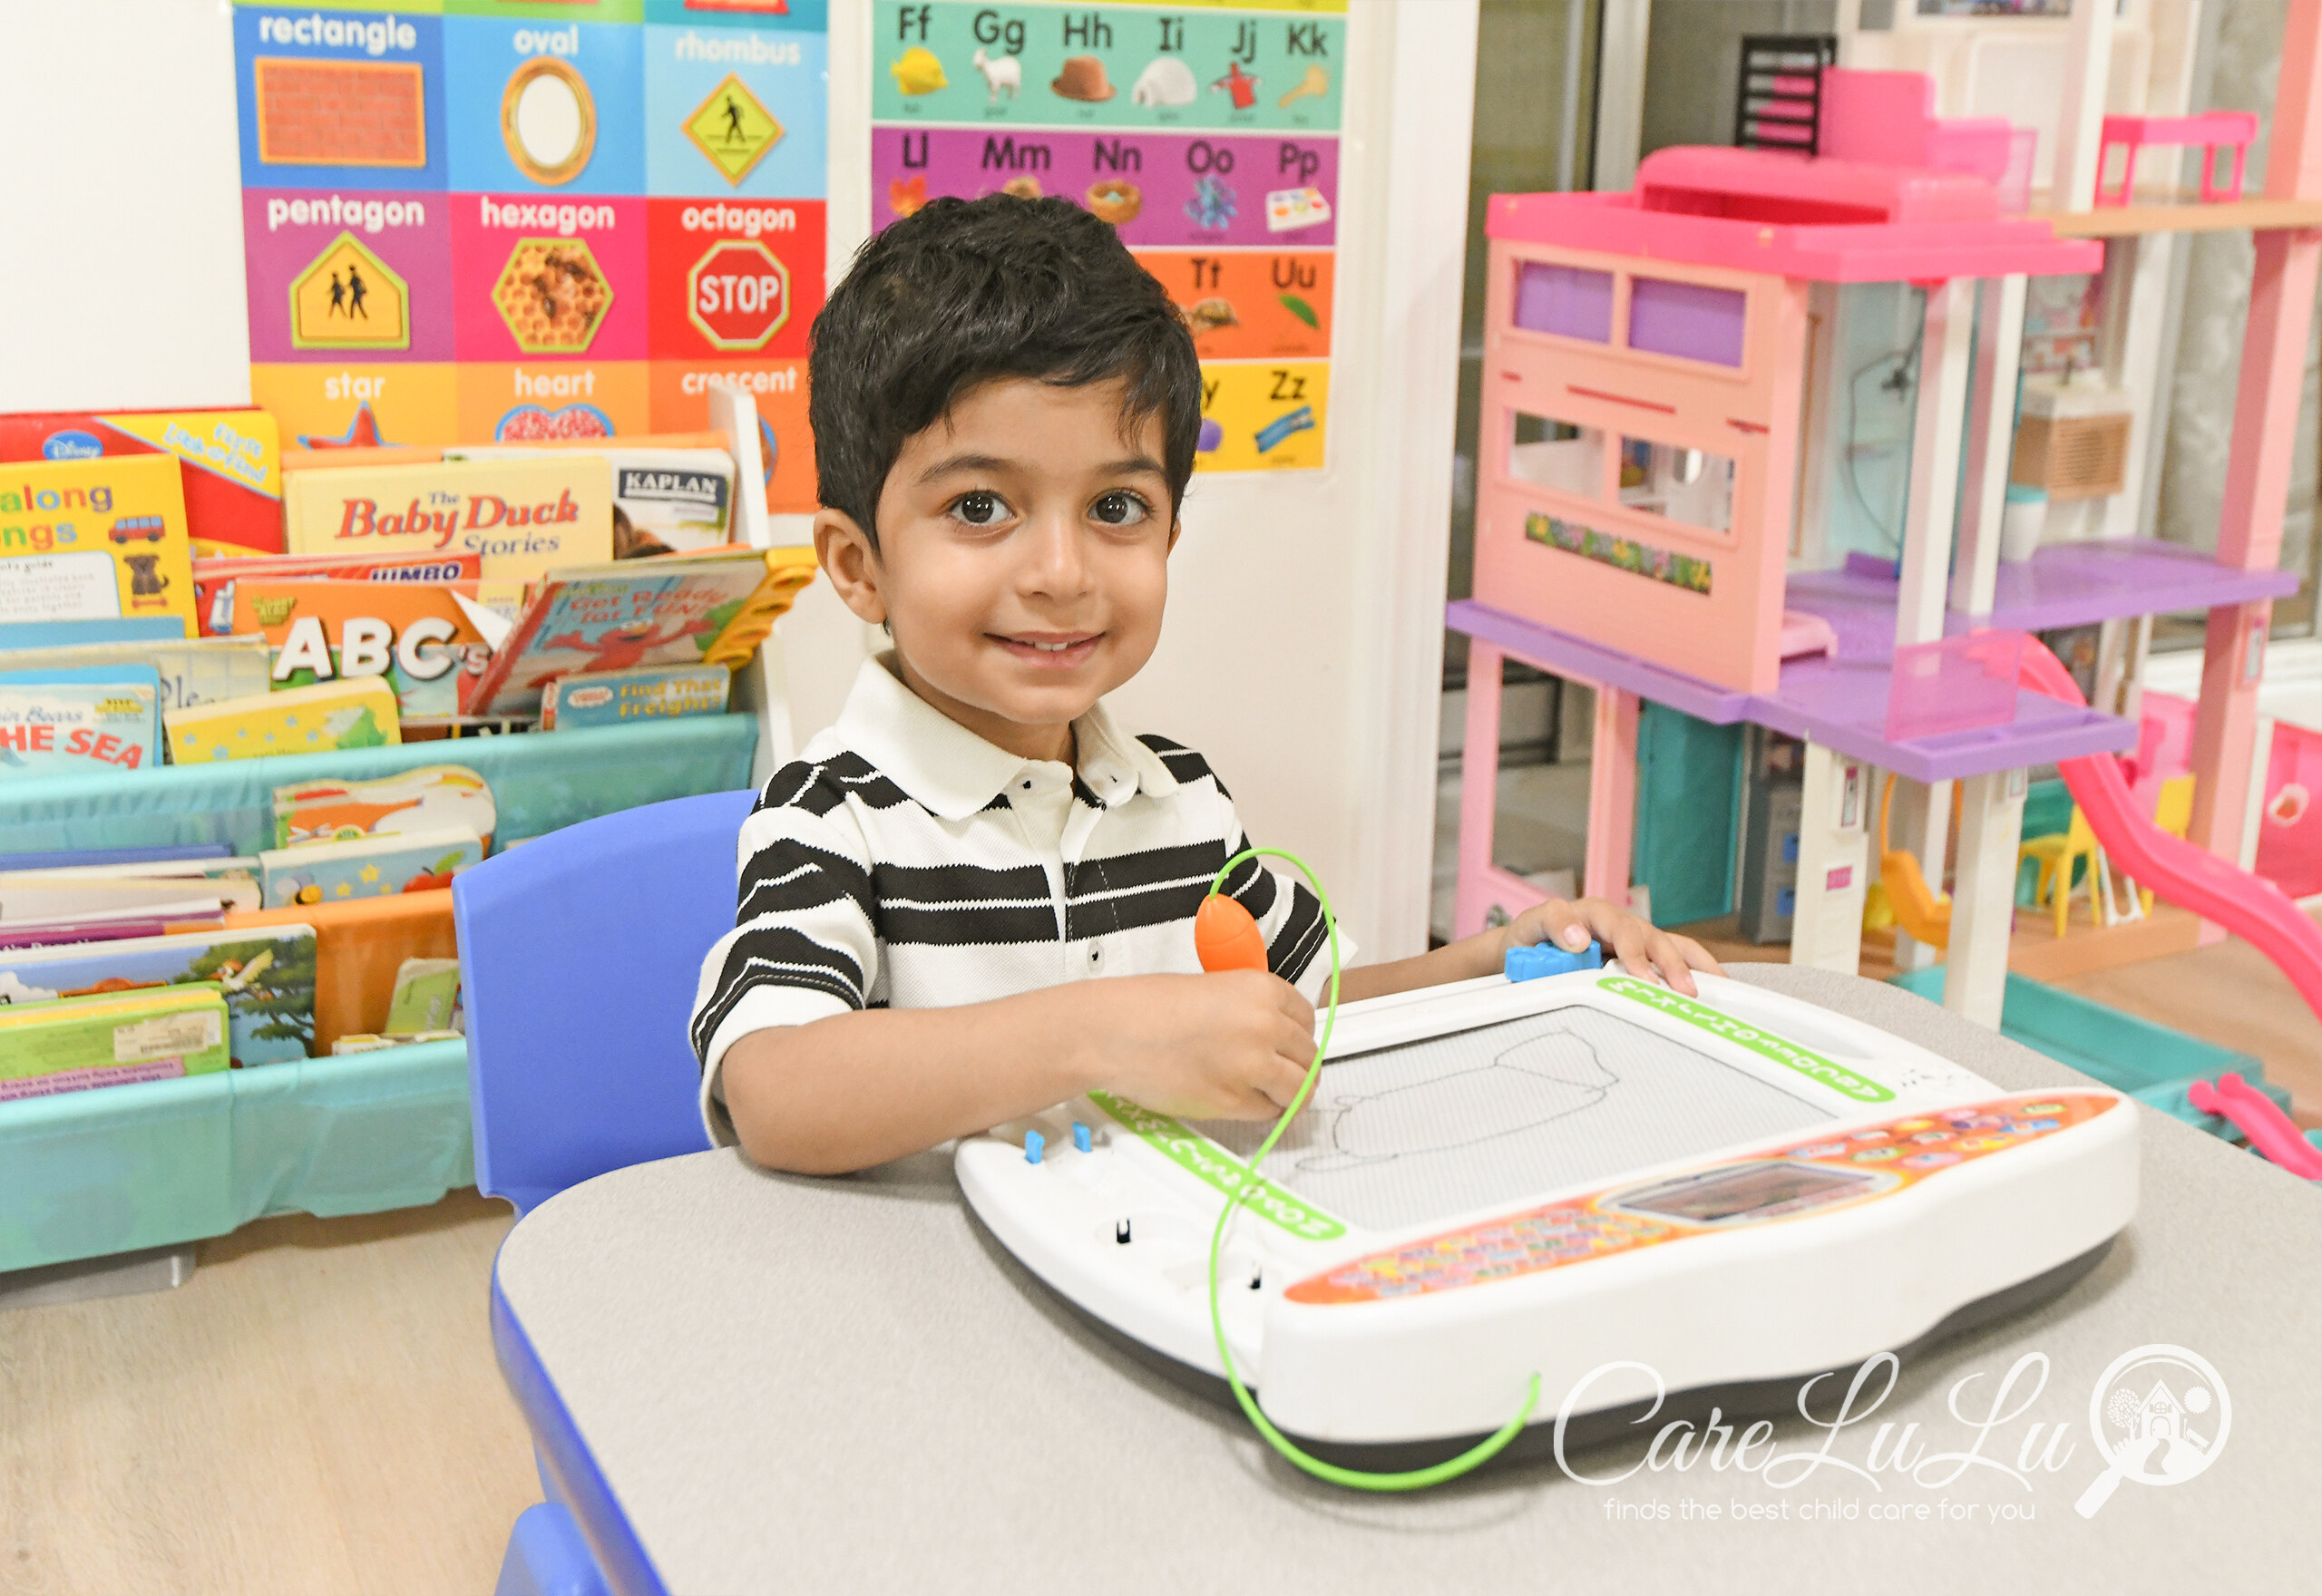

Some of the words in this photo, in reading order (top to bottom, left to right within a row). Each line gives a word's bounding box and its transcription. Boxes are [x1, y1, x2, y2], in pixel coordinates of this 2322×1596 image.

[259, 14, 418, 54] rectangle
[513, 24, 579, 55] oval
[675, 29, 802, 66] rhombus
[898, 5, 931, 42] Ff
[972, 10, 1027, 54] Gg
[1063, 14, 1113, 49] Hh
[1230, 20, 1258, 63] Jj
[1286, 23, 1328, 56] Kk
[981, 136, 1051, 170] Mm
[1094, 139, 1142, 172] Nn
[1186, 141, 1235, 175] Oo
[1278, 142, 1320, 181] Pp
[268, 194, 425, 232] pentagon
[481, 196, 616, 235] hexagon
[681, 203, 796, 238] octagon
[1191, 257, 1222, 290] Tt
[1273, 257, 1317, 289] Uu
[699, 275, 780, 315] STOP
[325, 372, 385, 399] star
[514, 368, 596, 396] heart
[681, 367, 797, 394] crescent
[1271, 370, 1307, 401] Zz
[0, 485, 113, 513] along
[429, 491, 460, 505] The
[626, 472, 717, 495] KAPLAN
[335, 498, 458, 550] Baby
[463, 487, 580, 530] Duck
[0, 522, 78, 552] ngs
[463, 530, 561, 557] Stories
[272, 615, 492, 682] ABC's
[620, 681, 668, 698] Find
[675, 678, 721, 695] That
[620, 696, 720, 717] Freight!
[64, 728, 143, 770] SEA
